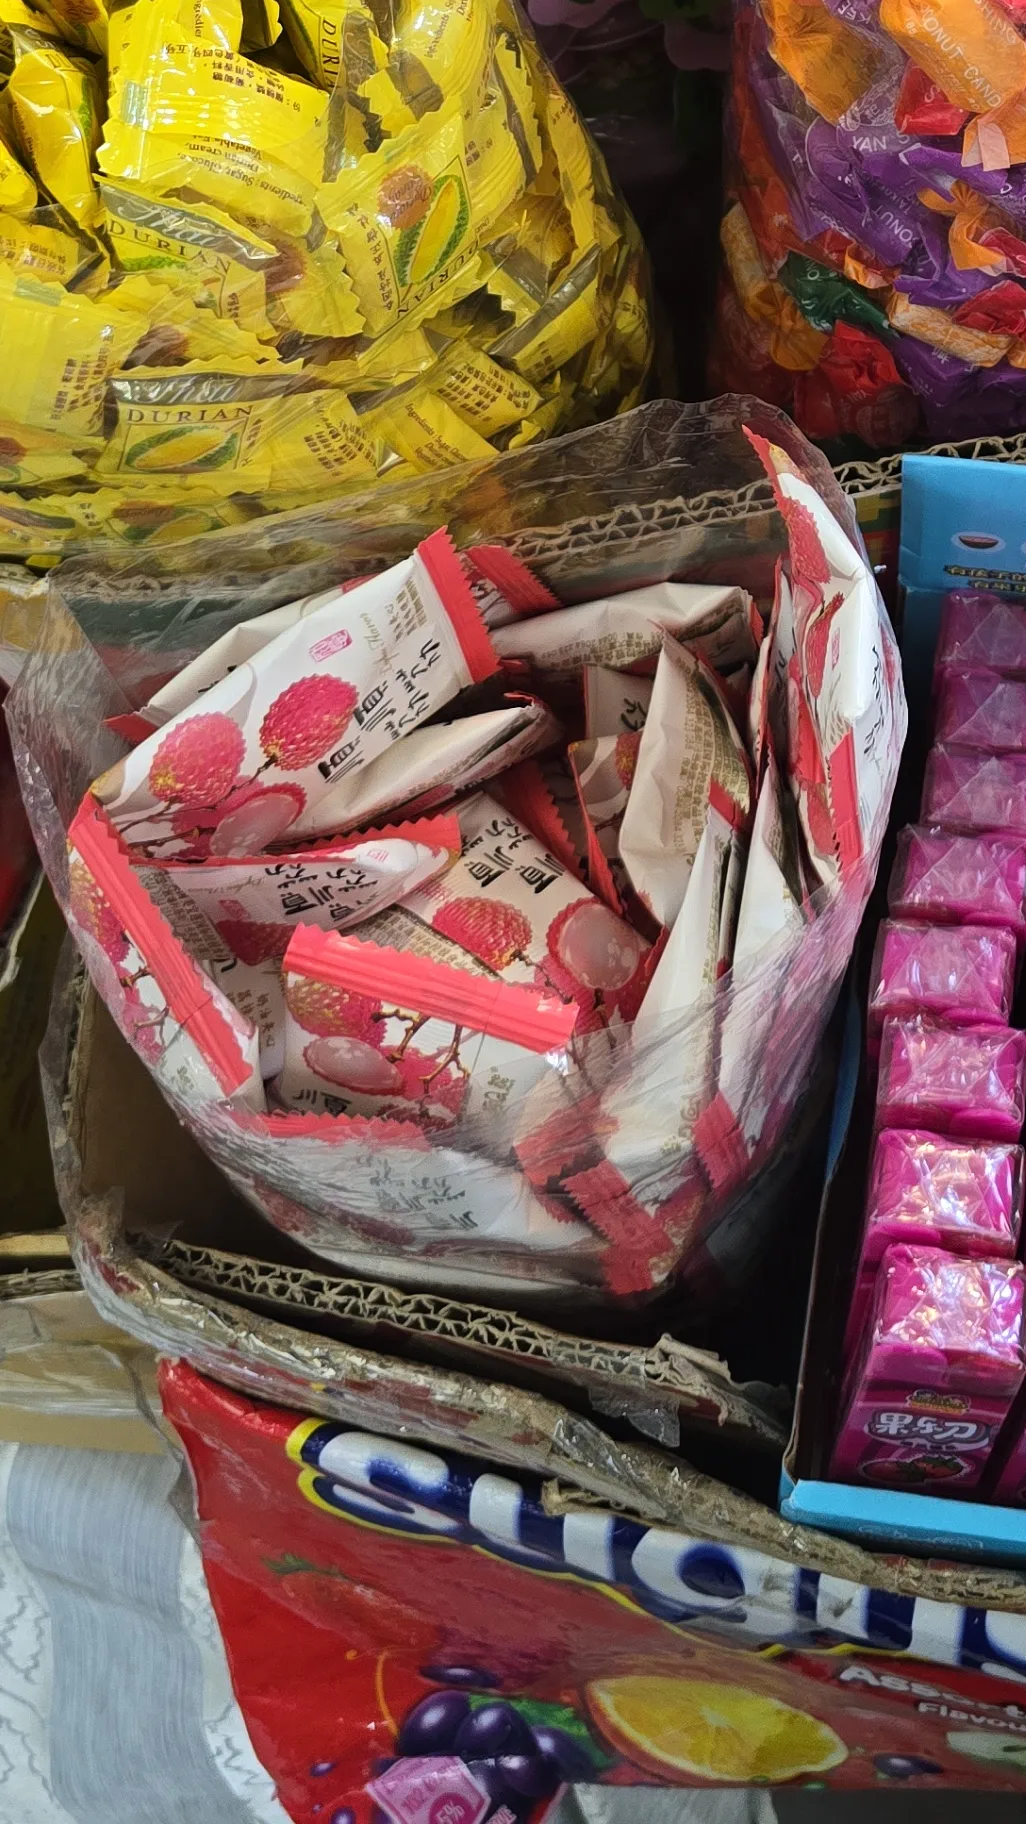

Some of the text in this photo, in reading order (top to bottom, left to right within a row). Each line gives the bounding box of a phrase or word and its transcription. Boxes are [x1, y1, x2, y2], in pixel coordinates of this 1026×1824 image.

[852, 135, 888, 153] YAN
[107, 219, 231, 275] DURIAN
[126, 405, 253, 423] DURIAN
[873, 1410, 979, 1441] 果乐刀
